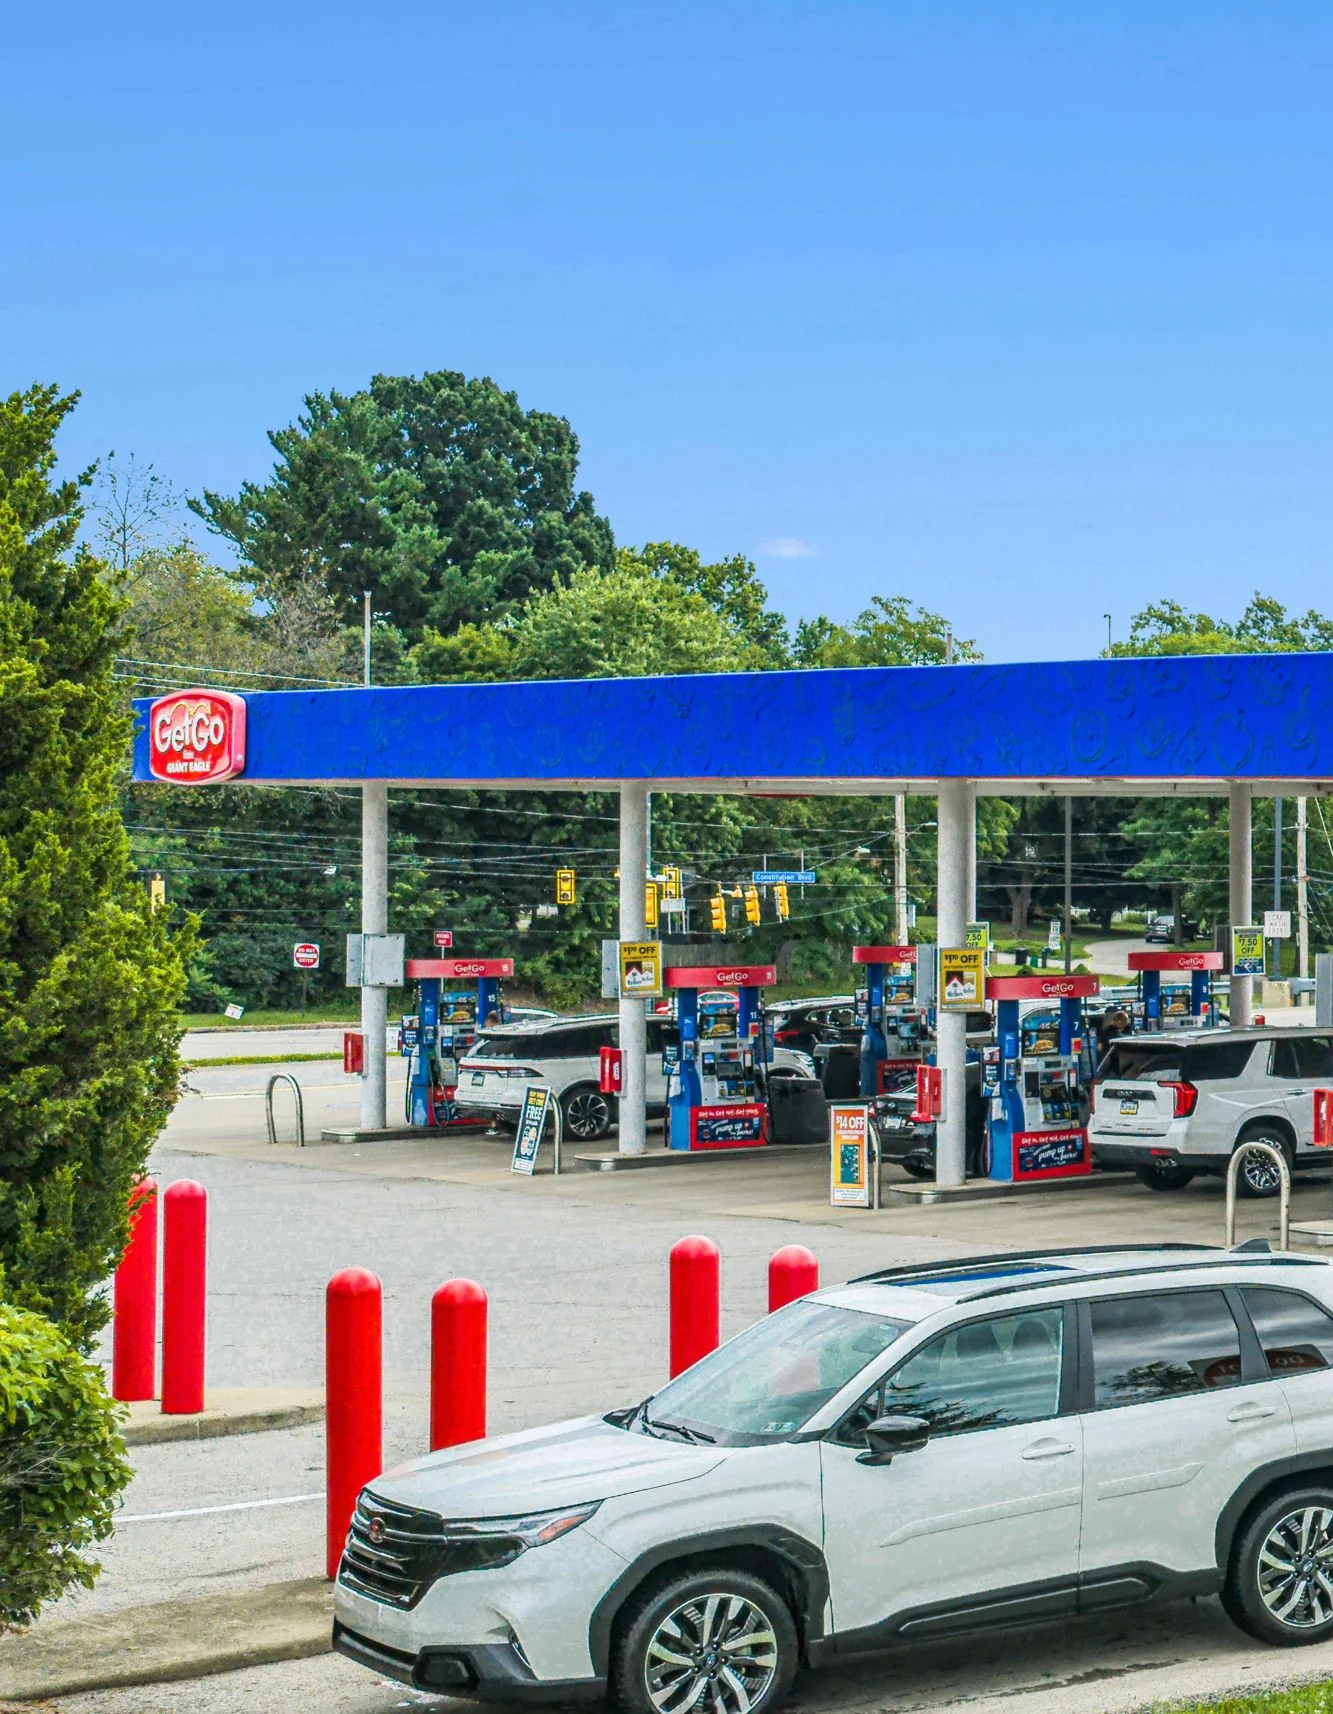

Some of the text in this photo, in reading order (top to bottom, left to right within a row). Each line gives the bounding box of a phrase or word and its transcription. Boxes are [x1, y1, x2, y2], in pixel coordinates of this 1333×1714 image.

[155, 712, 224, 753] GetGo
[167, 761, 211, 773] GIANT EAGLE
[639, 946, 656, 954] OFF
[960, 954, 979, 963] OFF
[1179, 957, 1204, 966] GetGo
[455, 963, 509, 973] GetGo 15
[717, 972, 748, 981] GetGo
[1042, 982, 1097, 992] GetGo 7
[1202, 985, 1207, 993] 9
[750, 1011, 757, 1019] 11
[1074, 1022, 1079, 1031] 7
[526, 1105, 543, 1120] FREE
[736, 1108, 745, 1116] Get
[836, 1116, 848, 1129] $14
[848, 1116, 865, 1129] OFF
[715, 1125, 733, 1135] pump
[734, 1123, 743, 1132] up
[1022, 1137, 1031, 1145] Get
[1038, 1149, 1056, 1163] pump
[1057, 1145, 1066, 1154] up
[1060, 1151, 1078, 1160] perks!
